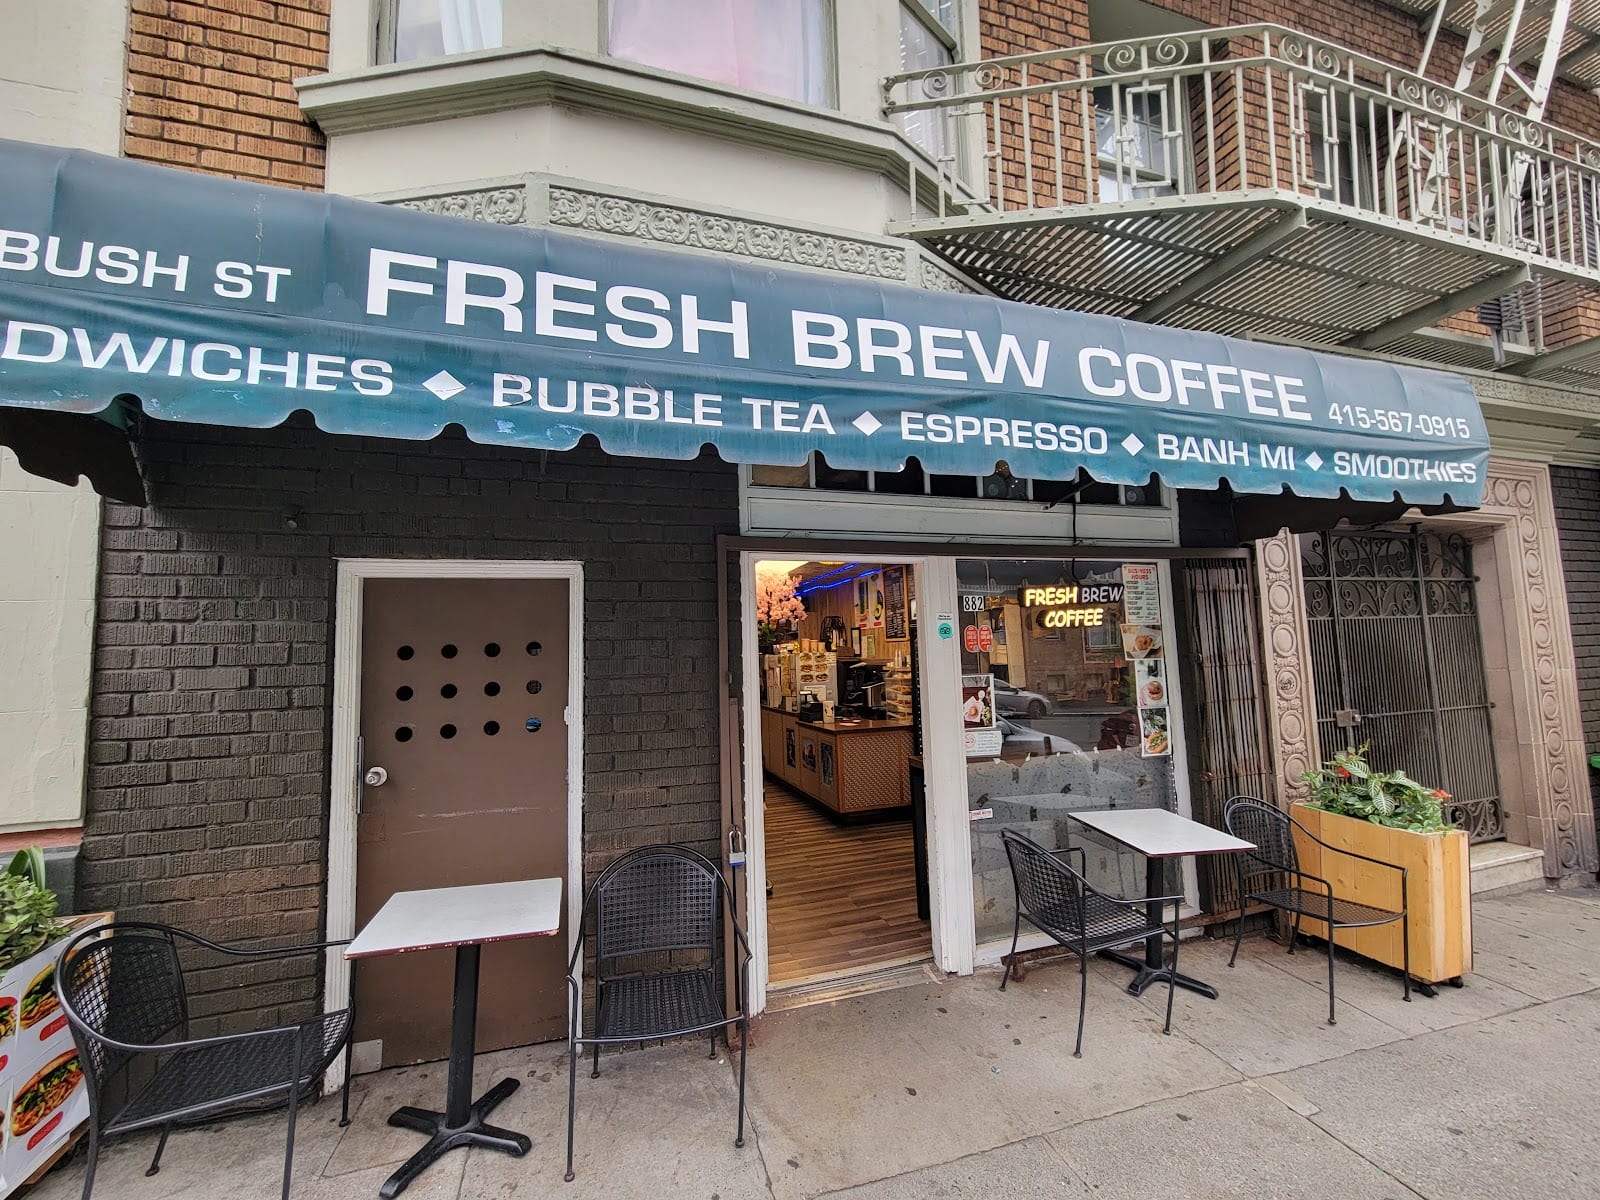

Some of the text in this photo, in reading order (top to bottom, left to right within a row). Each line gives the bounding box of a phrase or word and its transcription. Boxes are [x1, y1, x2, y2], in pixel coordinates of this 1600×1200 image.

[0, 229, 293, 304] BUSH ST
[365, 247, 1313, 423] FRESH BREW COFFEE
[1, 320, 1478, 485] DWICHES BUBBLE TEA ESPRESSO BANH MI SMOOTHIES
[1327, 401, 1472, 441] 415-567-0915
[964, 596, 984, 611] 882
[1025, 586, 1124, 607] FRESH BREW
[1045, 608, 1104, 628] COFFEE
